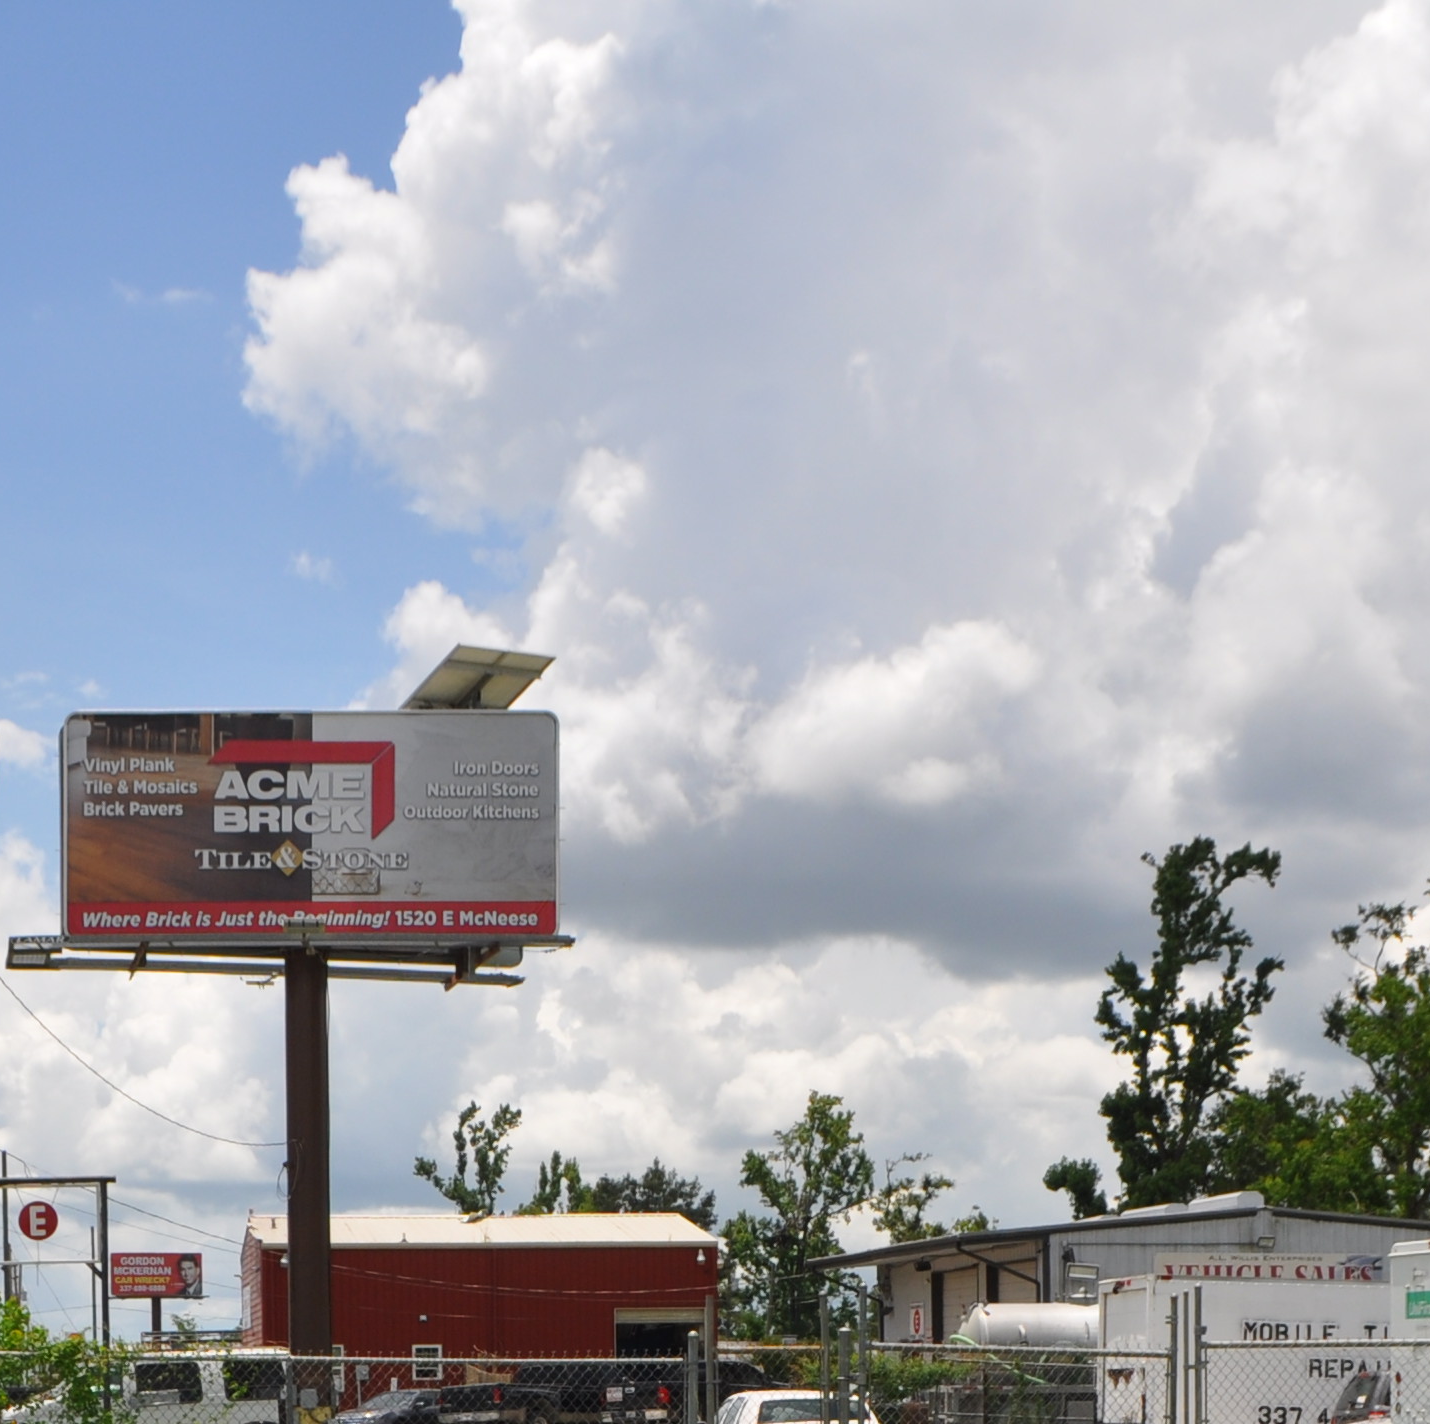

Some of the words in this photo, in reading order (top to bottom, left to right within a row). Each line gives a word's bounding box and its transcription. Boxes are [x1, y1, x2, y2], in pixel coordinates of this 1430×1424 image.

[83, 757, 125, 775] Vinyl
[129, 757, 175, 773] Plank
[453, 760, 487, 776] Iron
[491, 760, 539, 776] Doors
[83, 779, 113, 795] Tile
[117, 779, 129, 795] &
[133, 779, 199, 795] Mosaics
[214, 769, 365, 800] ACME
[427, 782, 488, 797] Natural
[491, 782, 538, 797] Stone
[83, 801, 125, 817] Brick
[129, 801, 184, 817] Pavers
[404, 804, 469, 819] Outdoor
[472, 804, 539, 819] Kitchens
[213, 805, 364, 834] BRICK
[82, 912, 140, 927] Where
[145, 911, 191, 927] Brick
[196, 911, 211, 926] is
[215, 911, 254, 927] Just
[258, 910, 285, 926] the
[395, 911, 437, 926] 1520
[442, 911, 454, 926] E
[459, 911, 538, 926] McNeese
[29, 1205, 46, 1236] E
[120, 1256, 165, 1266] GORDON
[114, 1266, 172, 1276] MCKERNAN
[115, 1276, 133, 1284] CAR
[1243, 1322, 1339, 1341] MOBILE
[1309, 1358, 1391, 1379] REPAI
